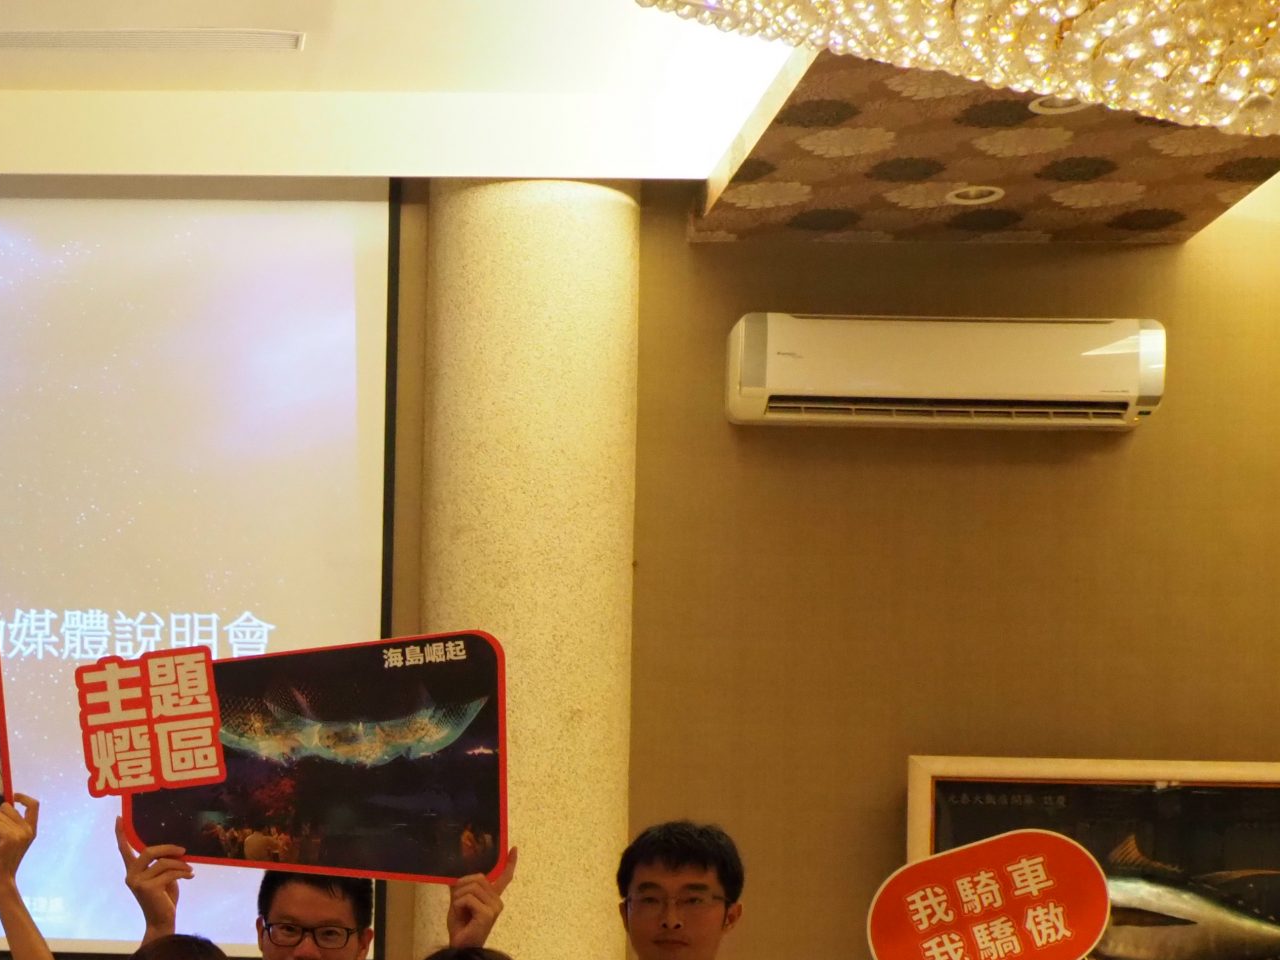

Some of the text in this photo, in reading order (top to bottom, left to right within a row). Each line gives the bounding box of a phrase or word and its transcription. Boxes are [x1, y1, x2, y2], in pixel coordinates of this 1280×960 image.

[81, 652, 211, 726] 主題
[382, 640, 467, 668] 海島崛起
[89, 716, 220, 791] 燈區
[905, 855, 1055, 931] 我騎車
